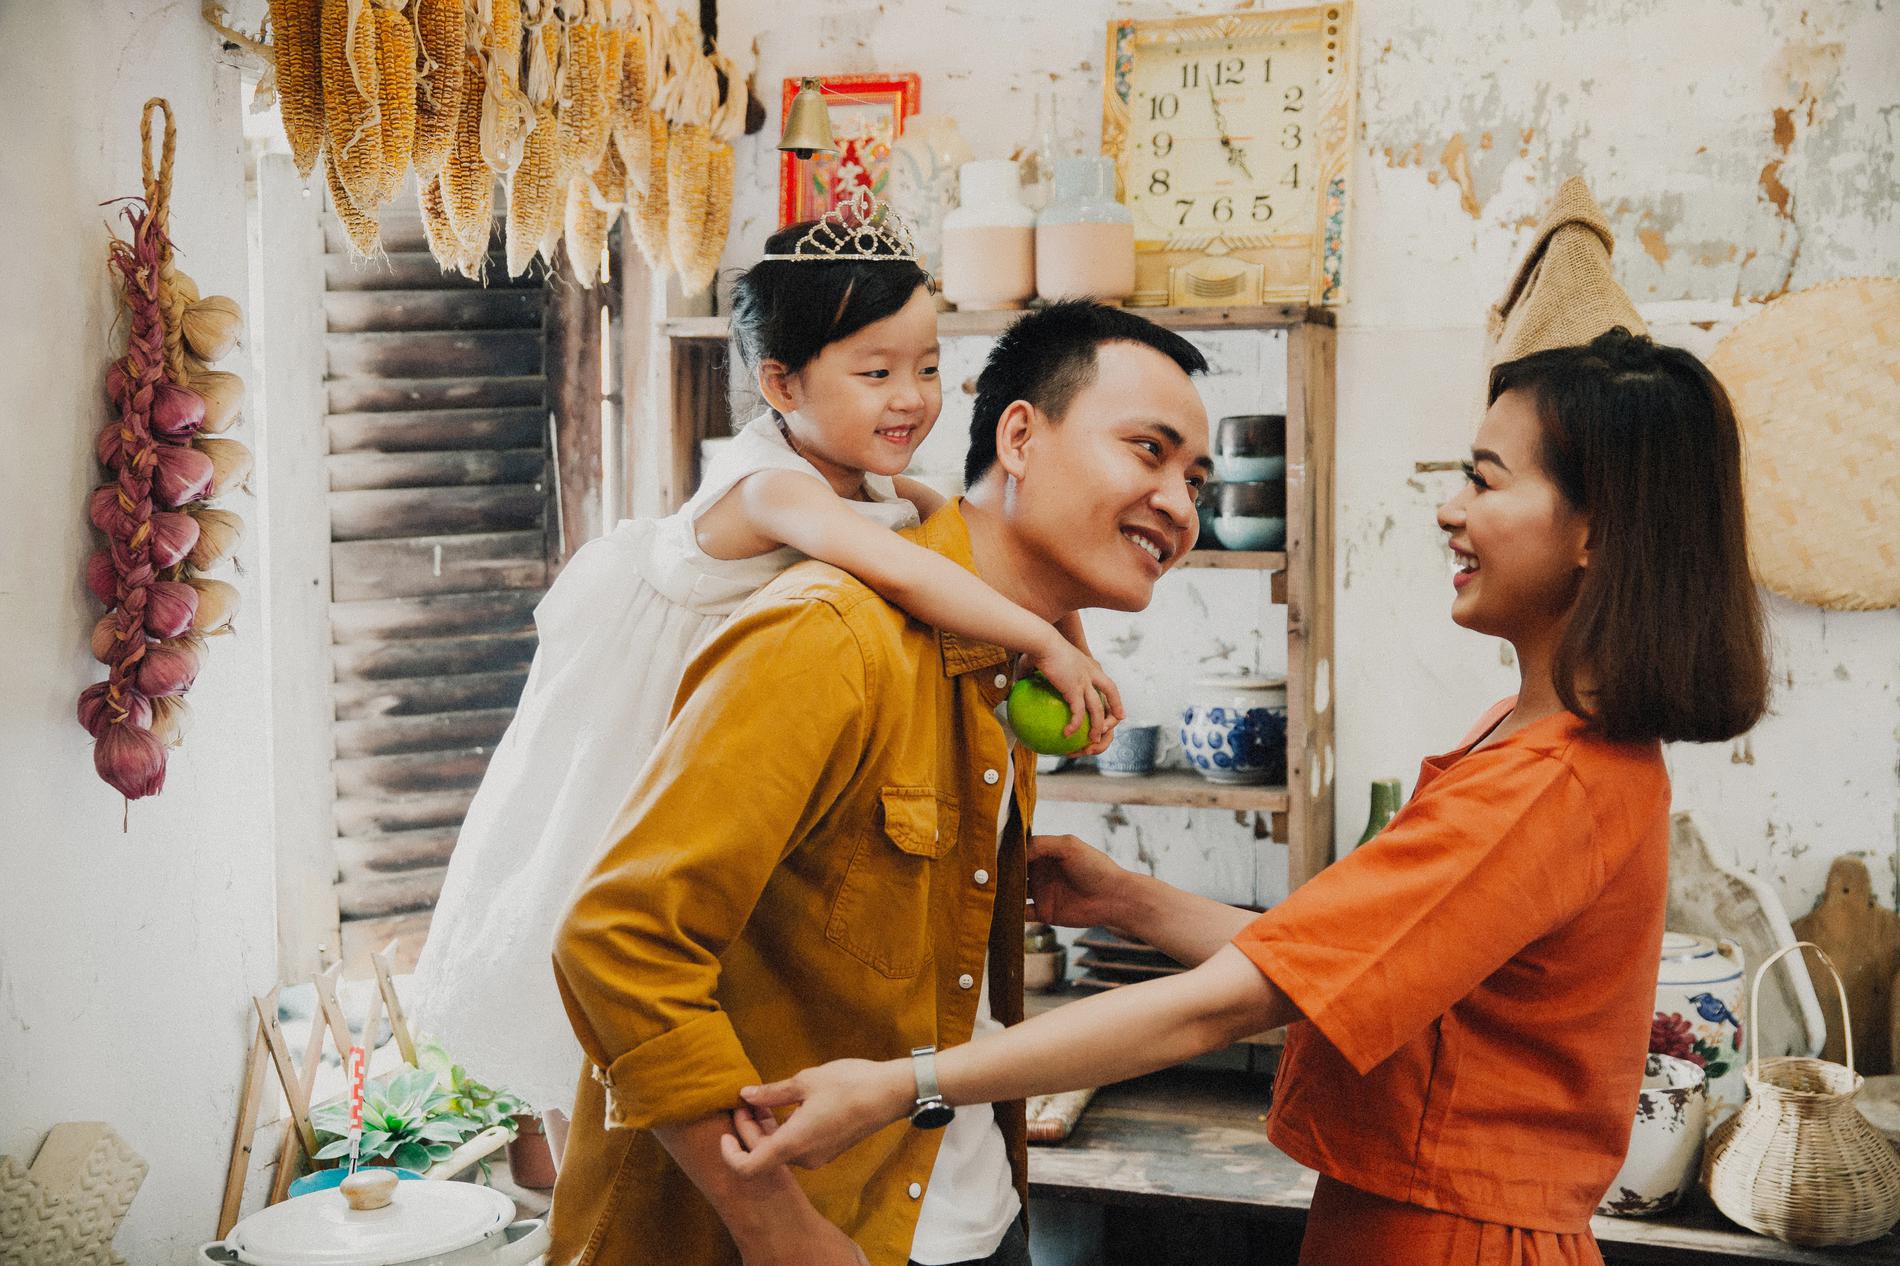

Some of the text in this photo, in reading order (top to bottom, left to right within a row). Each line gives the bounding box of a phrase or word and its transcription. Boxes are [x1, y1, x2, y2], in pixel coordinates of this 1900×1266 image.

[1182, 62, 1199, 88] 11
[1215, 58, 1245, 85] 12
[1264, 57, 1272, 83] 1
[1150, 93, 1179, 121] 10
[1284, 86, 1303, 112] 2
[1152, 132, 1173, 158] 9
[1282, 123, 1301, 150] 3
[1149, 169, 1170, 196] 8
[1279, 163, 1299, 190] 4
[1175, 199, 1194, 225] 7
[1213, 197, 1233, 223] 6
[1252, 195, 1272, 222] 5
